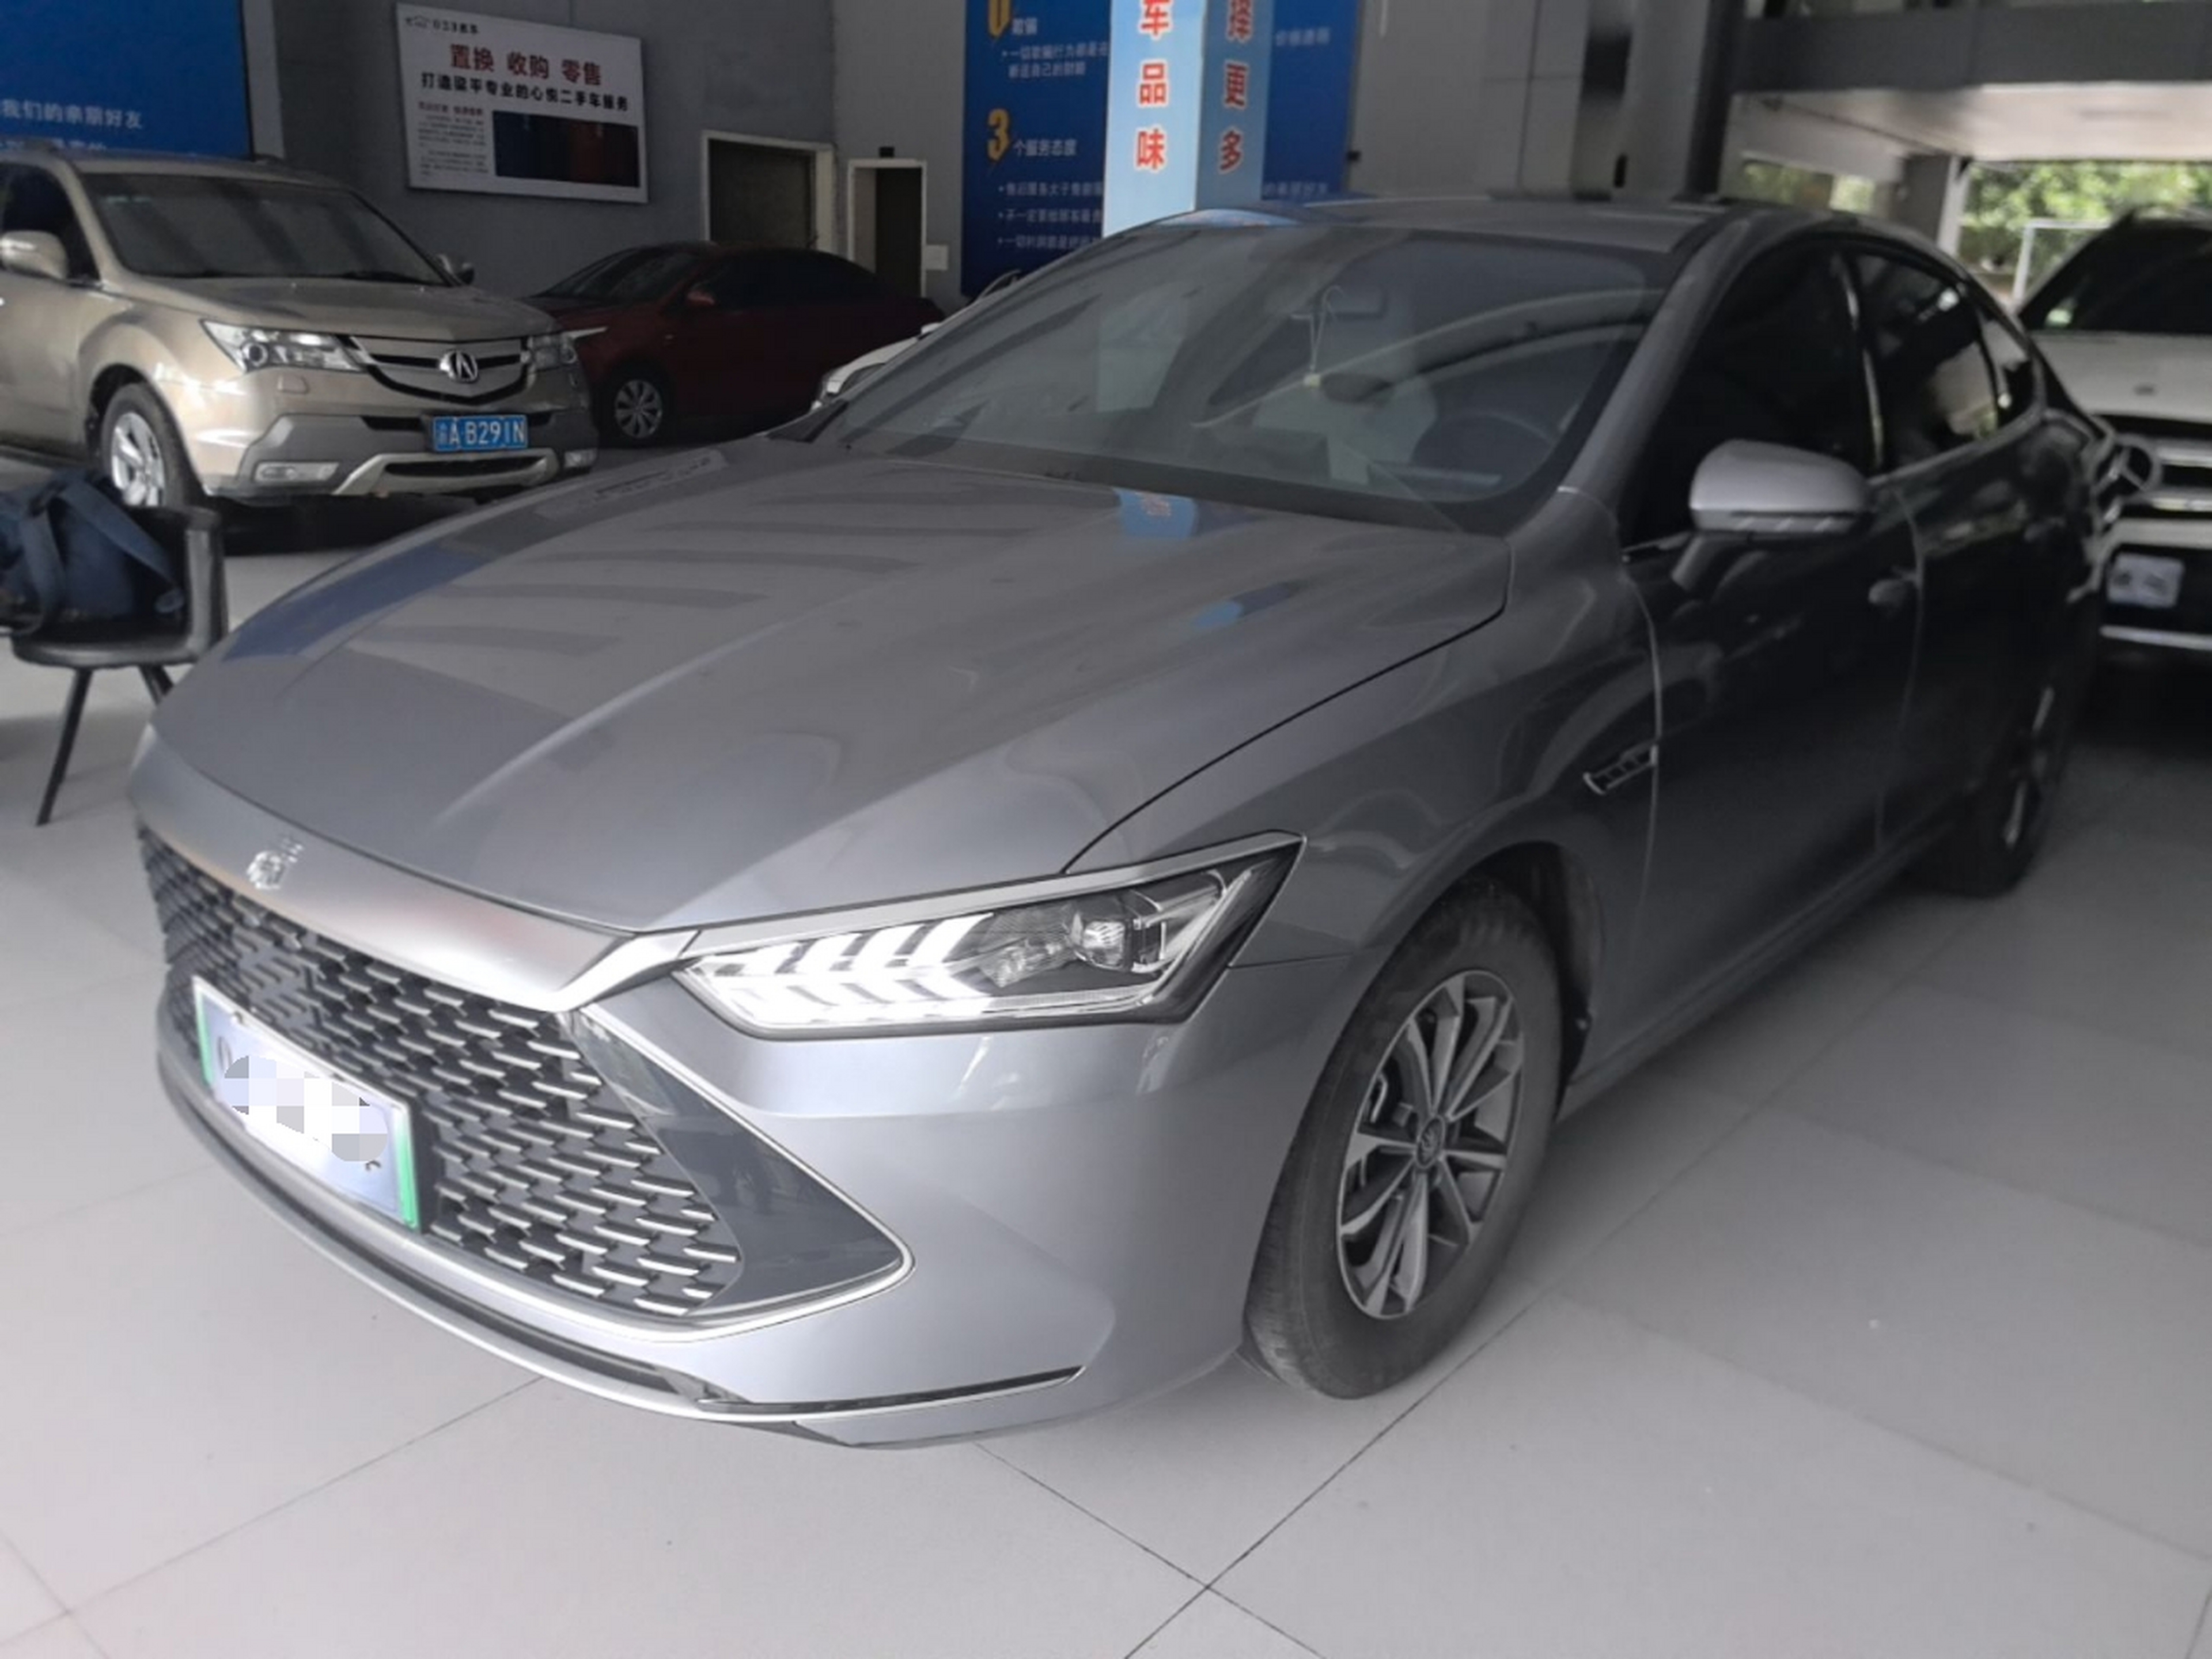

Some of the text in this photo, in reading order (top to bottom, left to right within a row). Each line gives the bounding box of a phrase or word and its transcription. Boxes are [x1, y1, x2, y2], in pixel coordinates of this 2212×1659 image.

[450, 44, 601, 86] 置换 收购 零售
